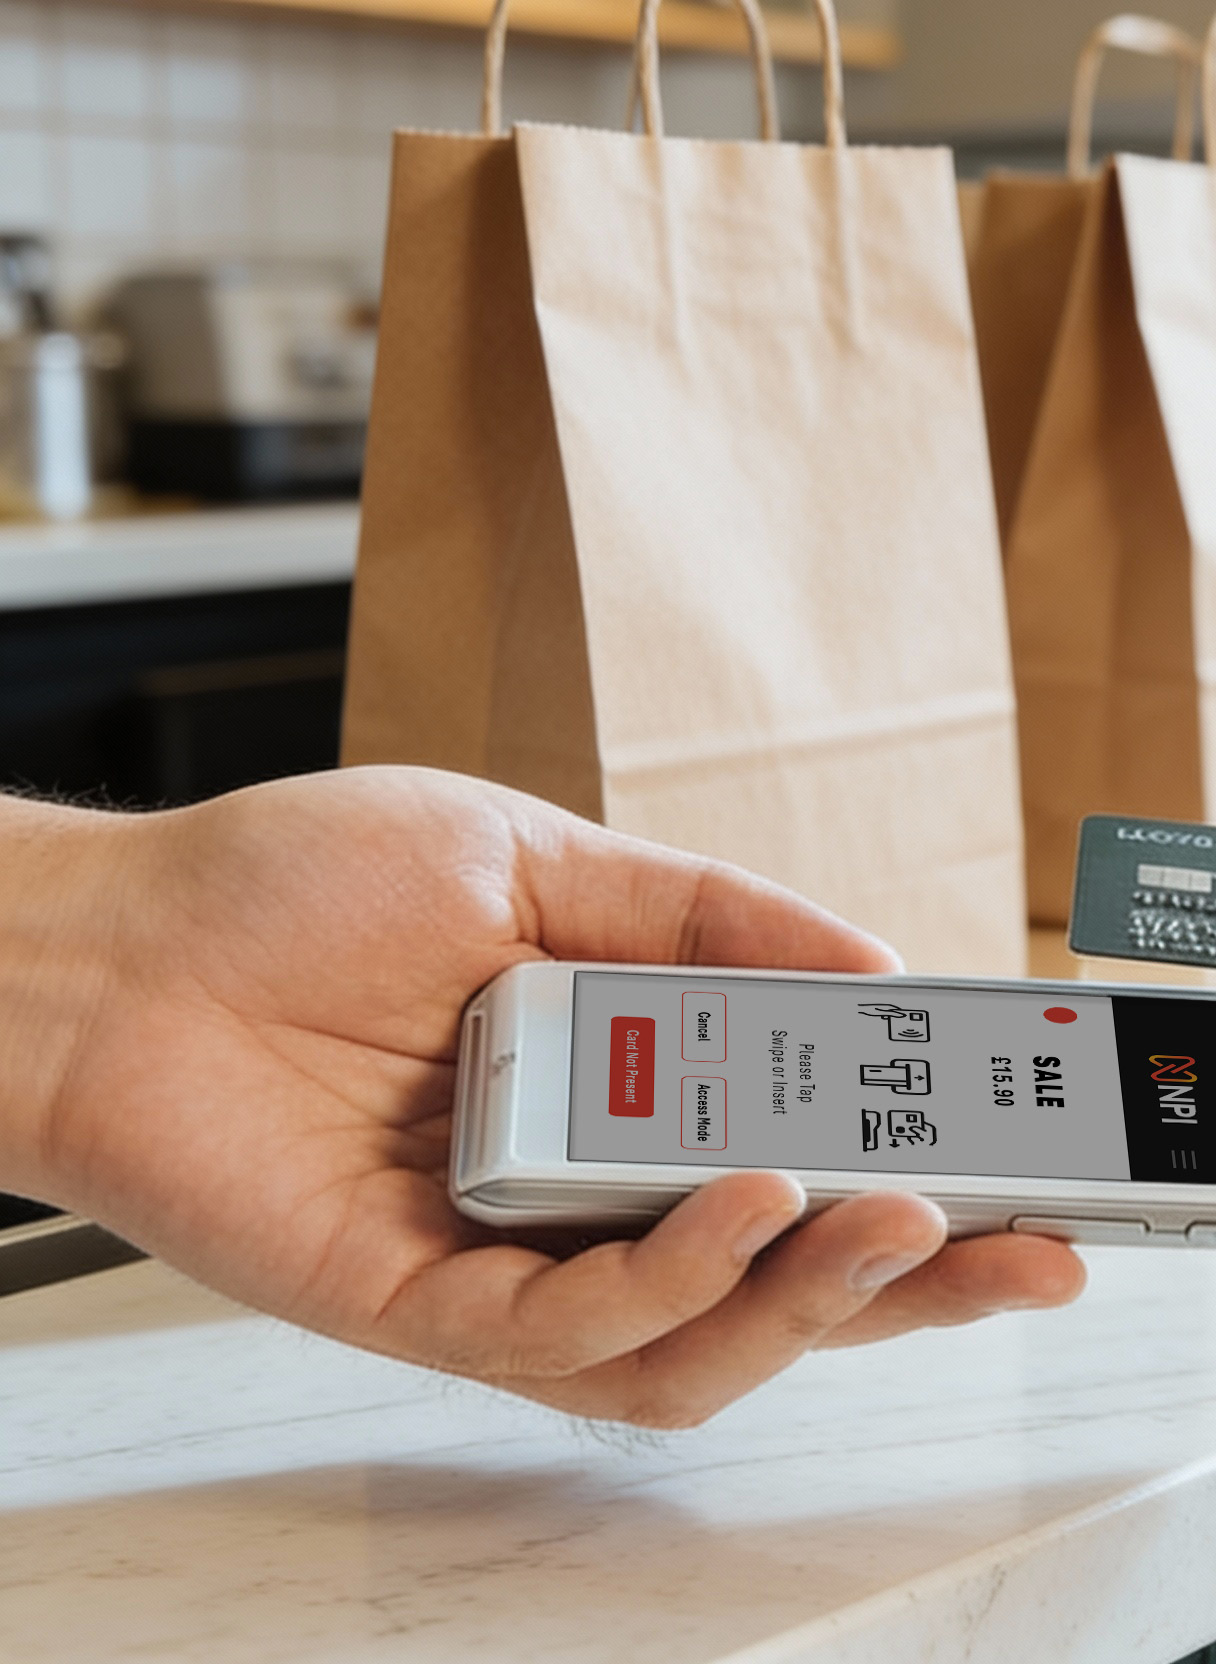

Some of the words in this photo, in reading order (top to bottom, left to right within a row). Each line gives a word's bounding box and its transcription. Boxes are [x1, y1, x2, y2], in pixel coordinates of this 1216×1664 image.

[627, 1030, 639, 1050] Card
[698, 1012, 711, 1042] Cancel
[626, 1053, 639, 1068] Not
[769, 1030, 788, 1063] Swipe
[800, 1044, 815, 1080] Please
[625, 1070, 639, 1103] Present
[772, 1067, 785, 1079] or
[991, 1056, 1015, 1106] £15.90
[1033, 1056, 1065, 1108] SALE
[698, 1084, 711, 1116] Access
[773, 1082, 788, 1115] Insert
[797, 1084, 816, 1103] Tap
[1157, 1084, 1198, 1124] NPI
[698, 1117, 711, 1142] Mode
